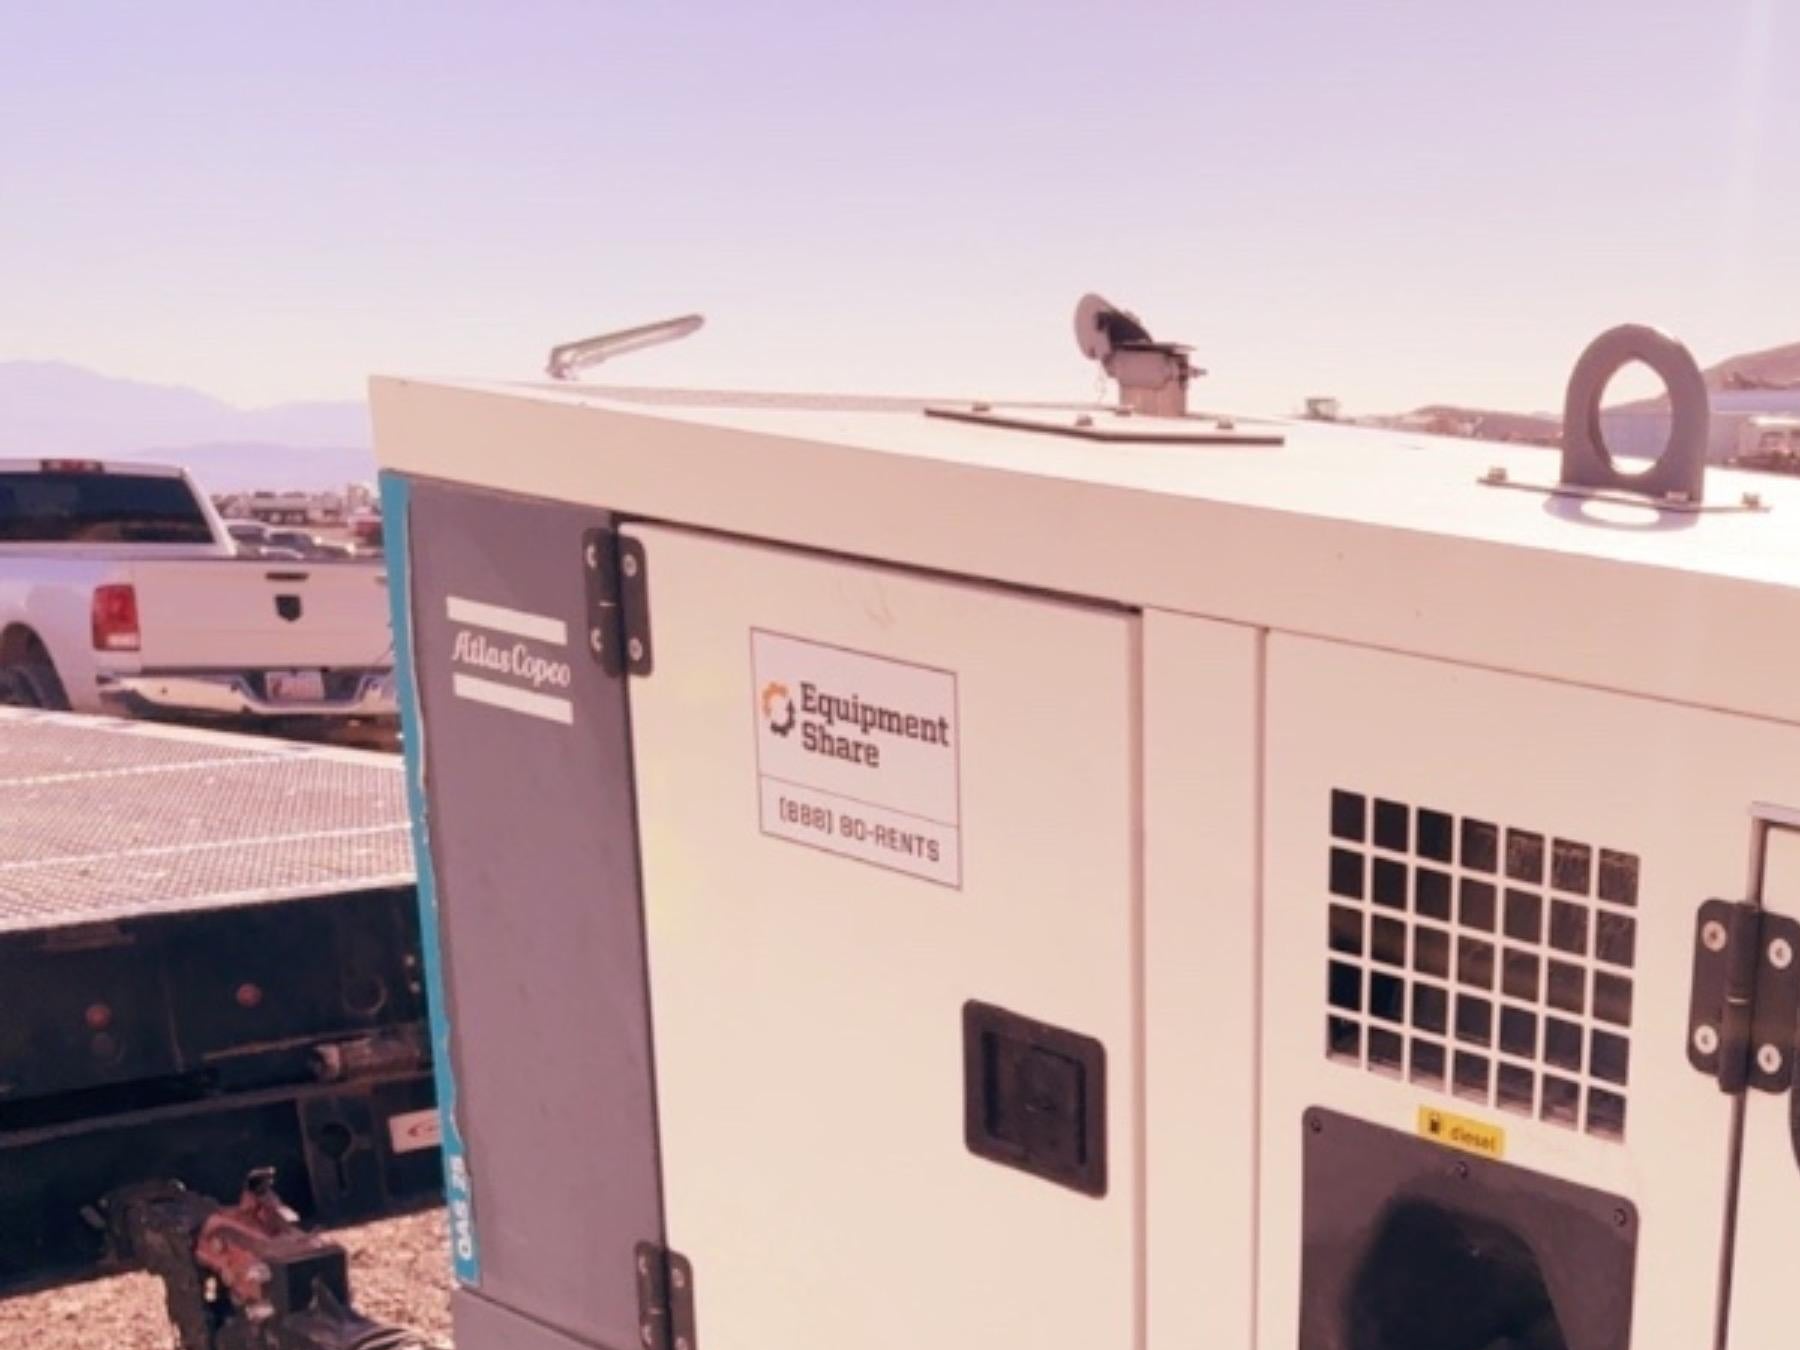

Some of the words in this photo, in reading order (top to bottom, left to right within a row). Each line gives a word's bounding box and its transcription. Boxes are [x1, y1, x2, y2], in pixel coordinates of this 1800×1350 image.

[452, 630, 510, 673] Atlas
[512, 643, 571, 688] Copco
[800, 681, 950, 747] Equipment
[801, 721, 881, 769] Share
[778, 797, 833, 835] (888)
[1450, 1125, 1496, 1153] diesel
